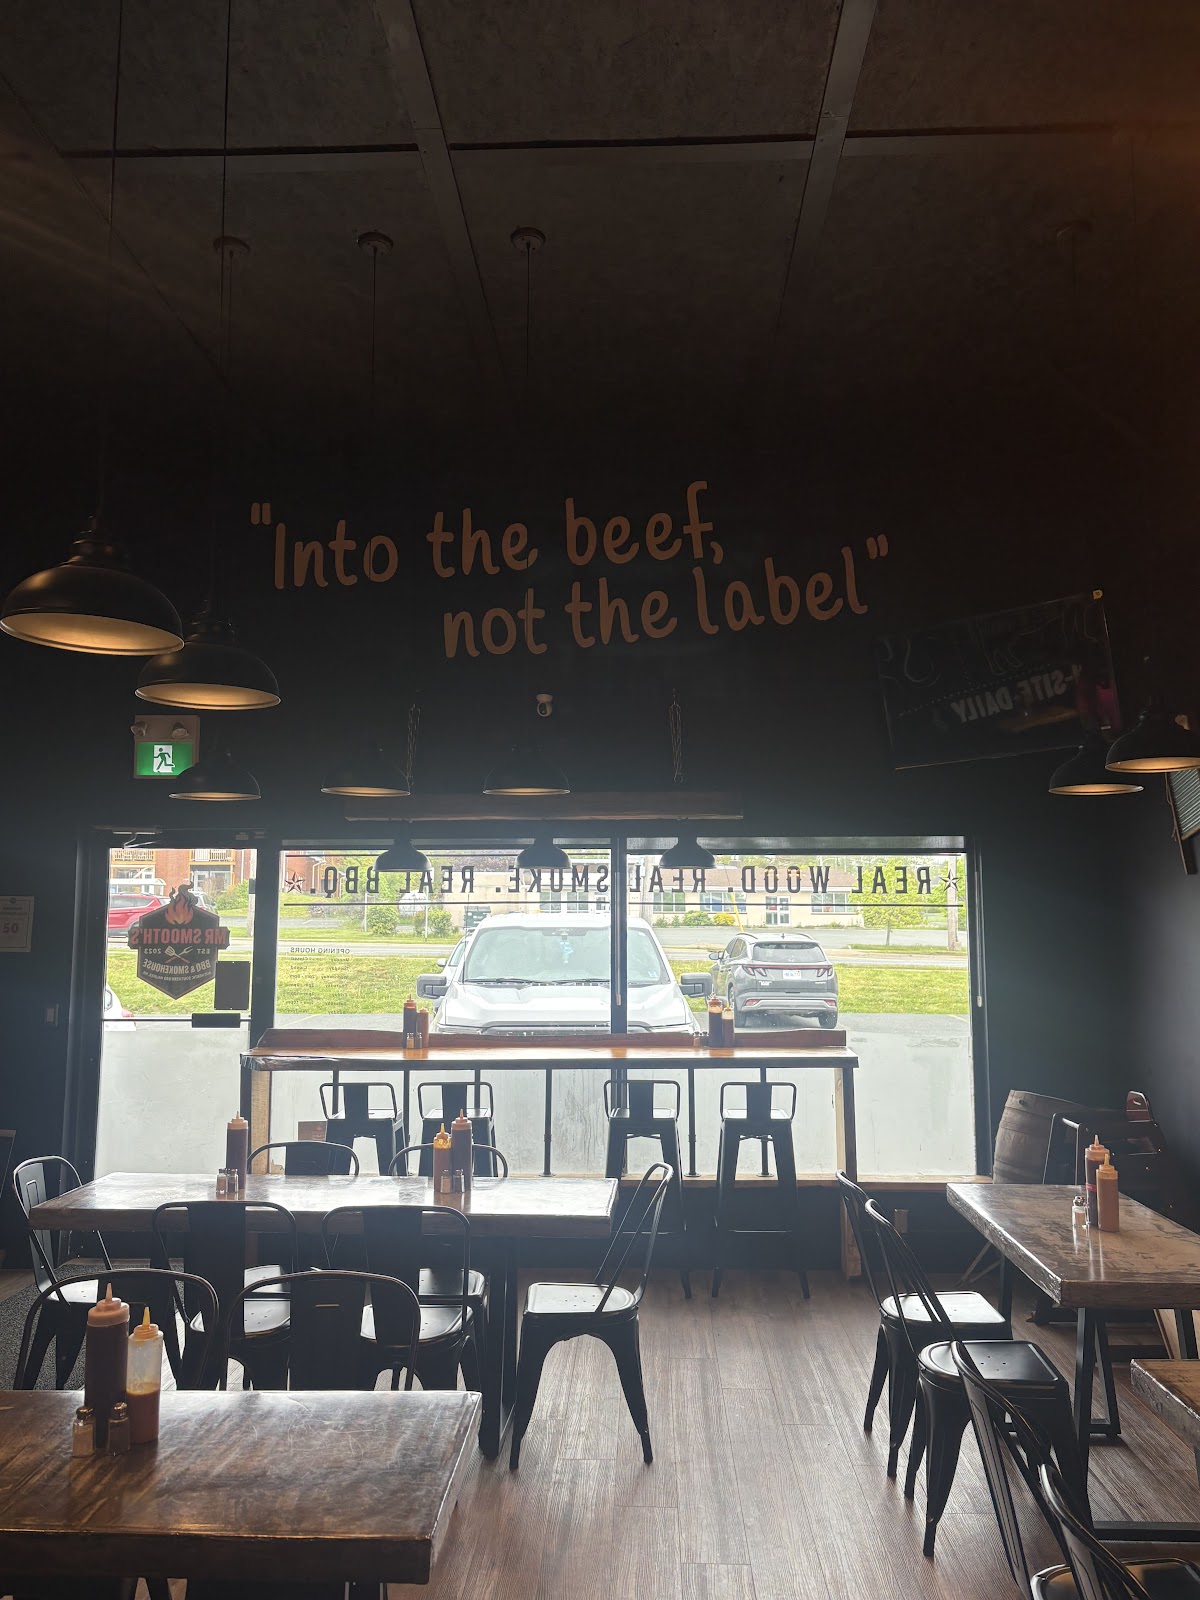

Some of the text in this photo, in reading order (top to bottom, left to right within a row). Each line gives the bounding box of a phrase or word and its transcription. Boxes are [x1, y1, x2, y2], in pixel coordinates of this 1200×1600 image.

[251, 481, 723, 588] "Into the beef,
[444, 534, 888, 658] not the label"
